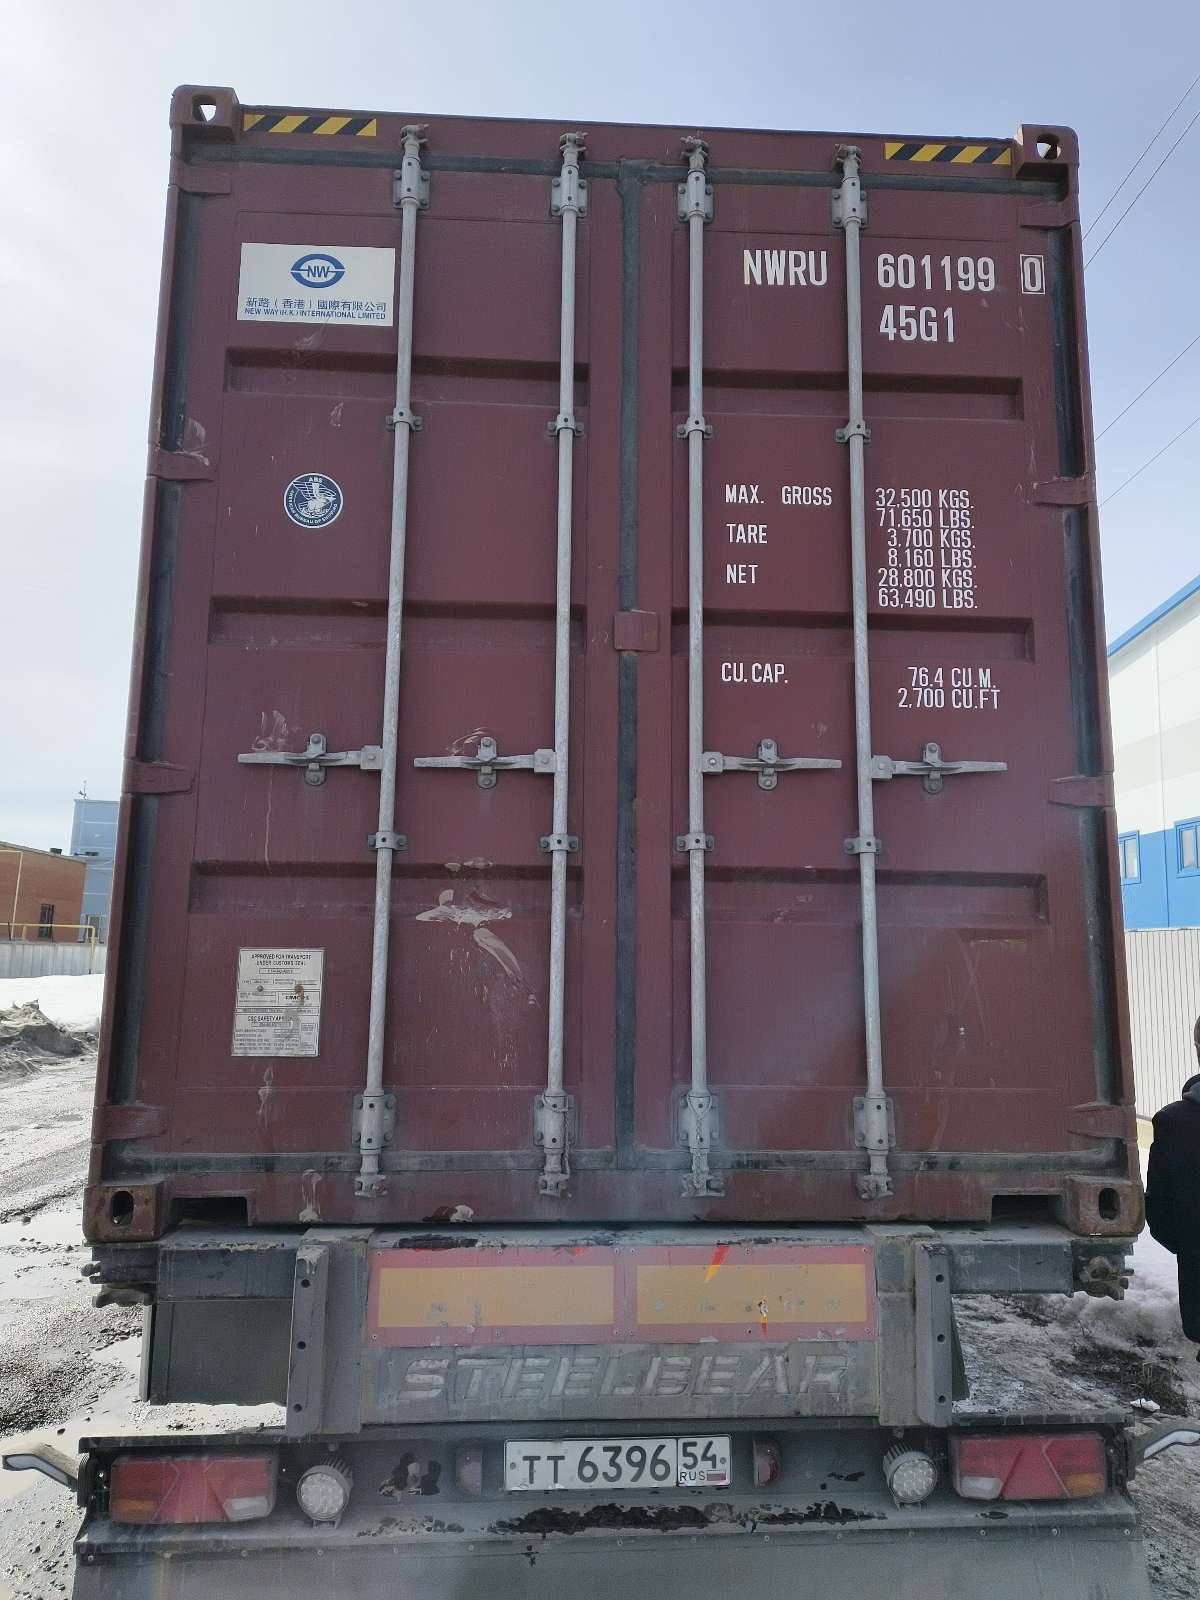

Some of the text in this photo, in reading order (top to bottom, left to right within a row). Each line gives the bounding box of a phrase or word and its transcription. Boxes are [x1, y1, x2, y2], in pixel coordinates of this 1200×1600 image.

[306, 265, 330, 278] NW
[743, 249, 828, 287] NWRU
[876, 252, 996, 292] 601199
[244, 307, 262, 315] NEW
[263, 308, 279, 316] WAY
[299, 310, 357, 319] INTERNATIONAL
[357, 311, 386, 320] LIMITED
[879, 304, 955, 343] 45G1
[725, 484, 833, 506] MAX. GROSS
[938, 488, 975, 509] KGS.
[939, 508, 975, 529] LBS.
[726, 523, 768, 544] TARE
[940, 528, 976, 549] KGS.
[940, 548, 977, 569] LBS.
[726, 564, 759, 584] NET
[941, 568, 978, 589] KGS.
[942, 588, 978, 609] LBS.
[907, 666, 944, 688] 76.4
[397, 1355, 850, 1400] STEELBEAR
[681, 1440, 718, 1470] 54
[679, 1470, 706, 1483] RUS
